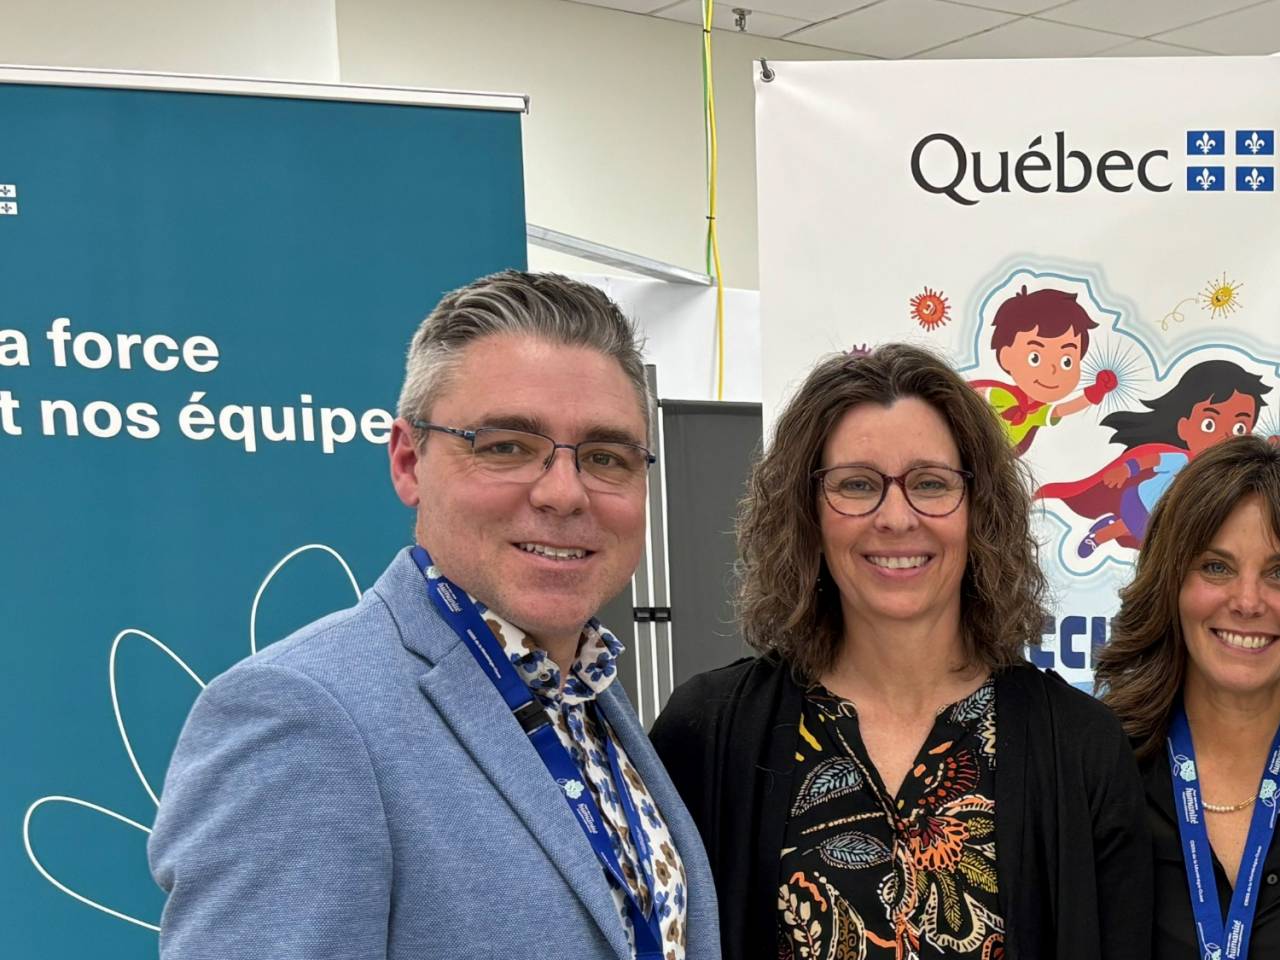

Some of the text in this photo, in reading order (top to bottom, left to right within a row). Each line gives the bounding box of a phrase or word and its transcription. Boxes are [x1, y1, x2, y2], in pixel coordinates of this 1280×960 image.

[910, 131, 1173, 206] Québec
[0, 317, 219, 373] a force
[40, 399, 160, 439] nos
[178, 391, 394, 454] équipe
